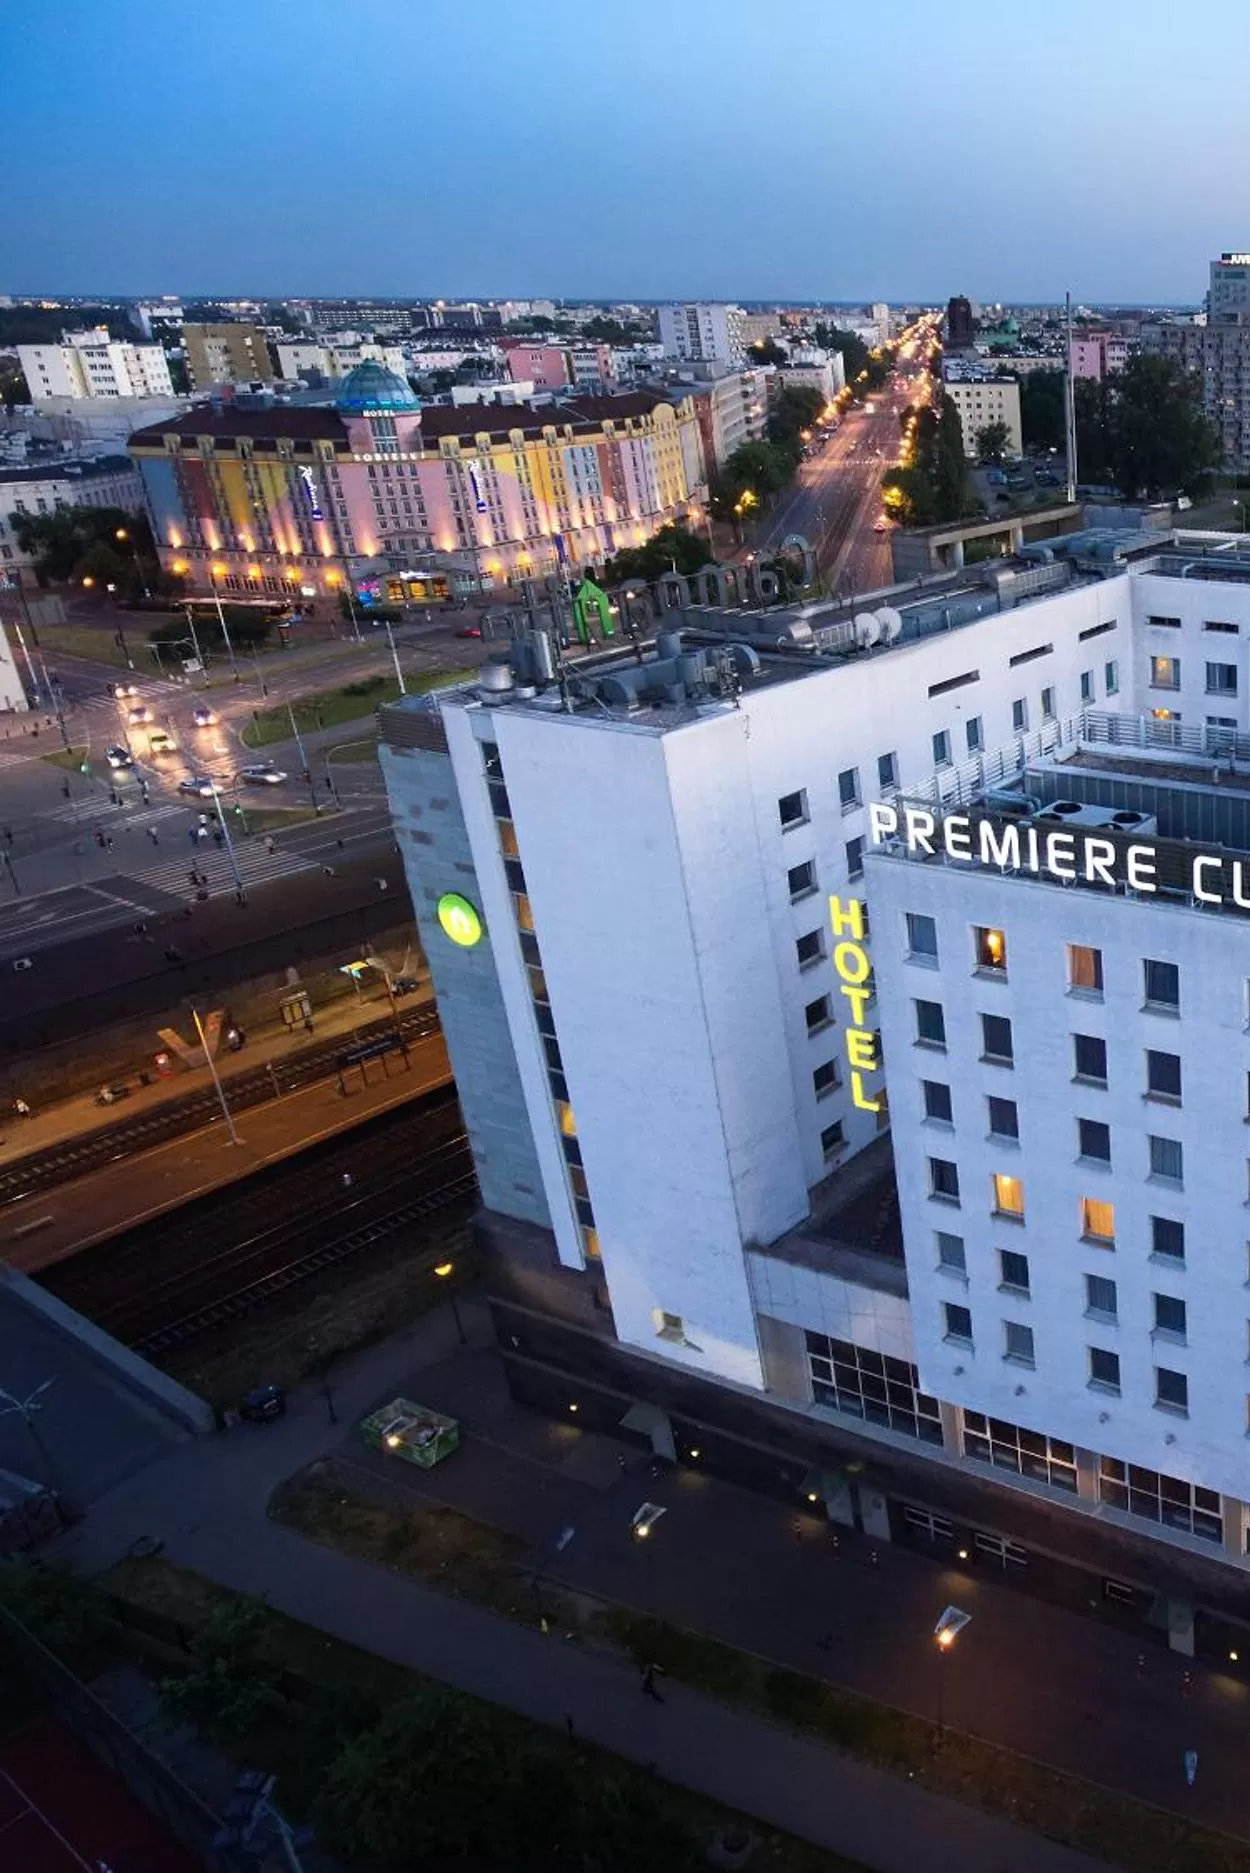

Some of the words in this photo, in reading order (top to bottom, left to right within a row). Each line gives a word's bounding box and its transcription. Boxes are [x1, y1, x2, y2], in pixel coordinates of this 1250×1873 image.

[363, 410, 396, 418] HOTEL
[868, 802, 1158, 892] PREMIERE
[829, 895, 880, 1112] HOTEL
